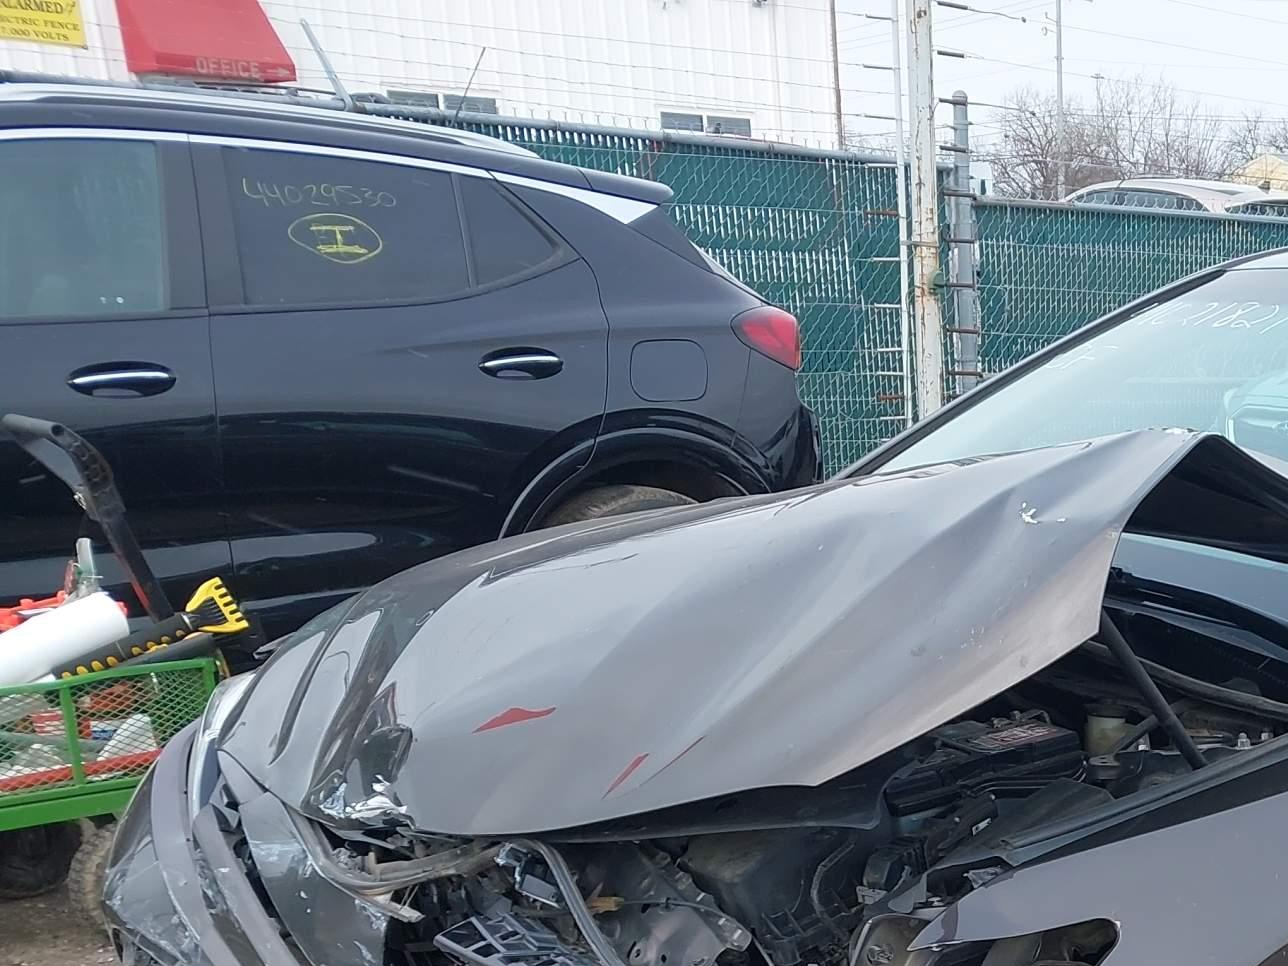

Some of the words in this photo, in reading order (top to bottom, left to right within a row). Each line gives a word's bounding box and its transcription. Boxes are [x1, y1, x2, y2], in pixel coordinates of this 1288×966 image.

[43, 19, 80, 32] FENCE
[32, 30, 70, 42] VOLTS
[195, 56, 262, 78] OFFICE
[242, 177, 397, 207] 44029530
